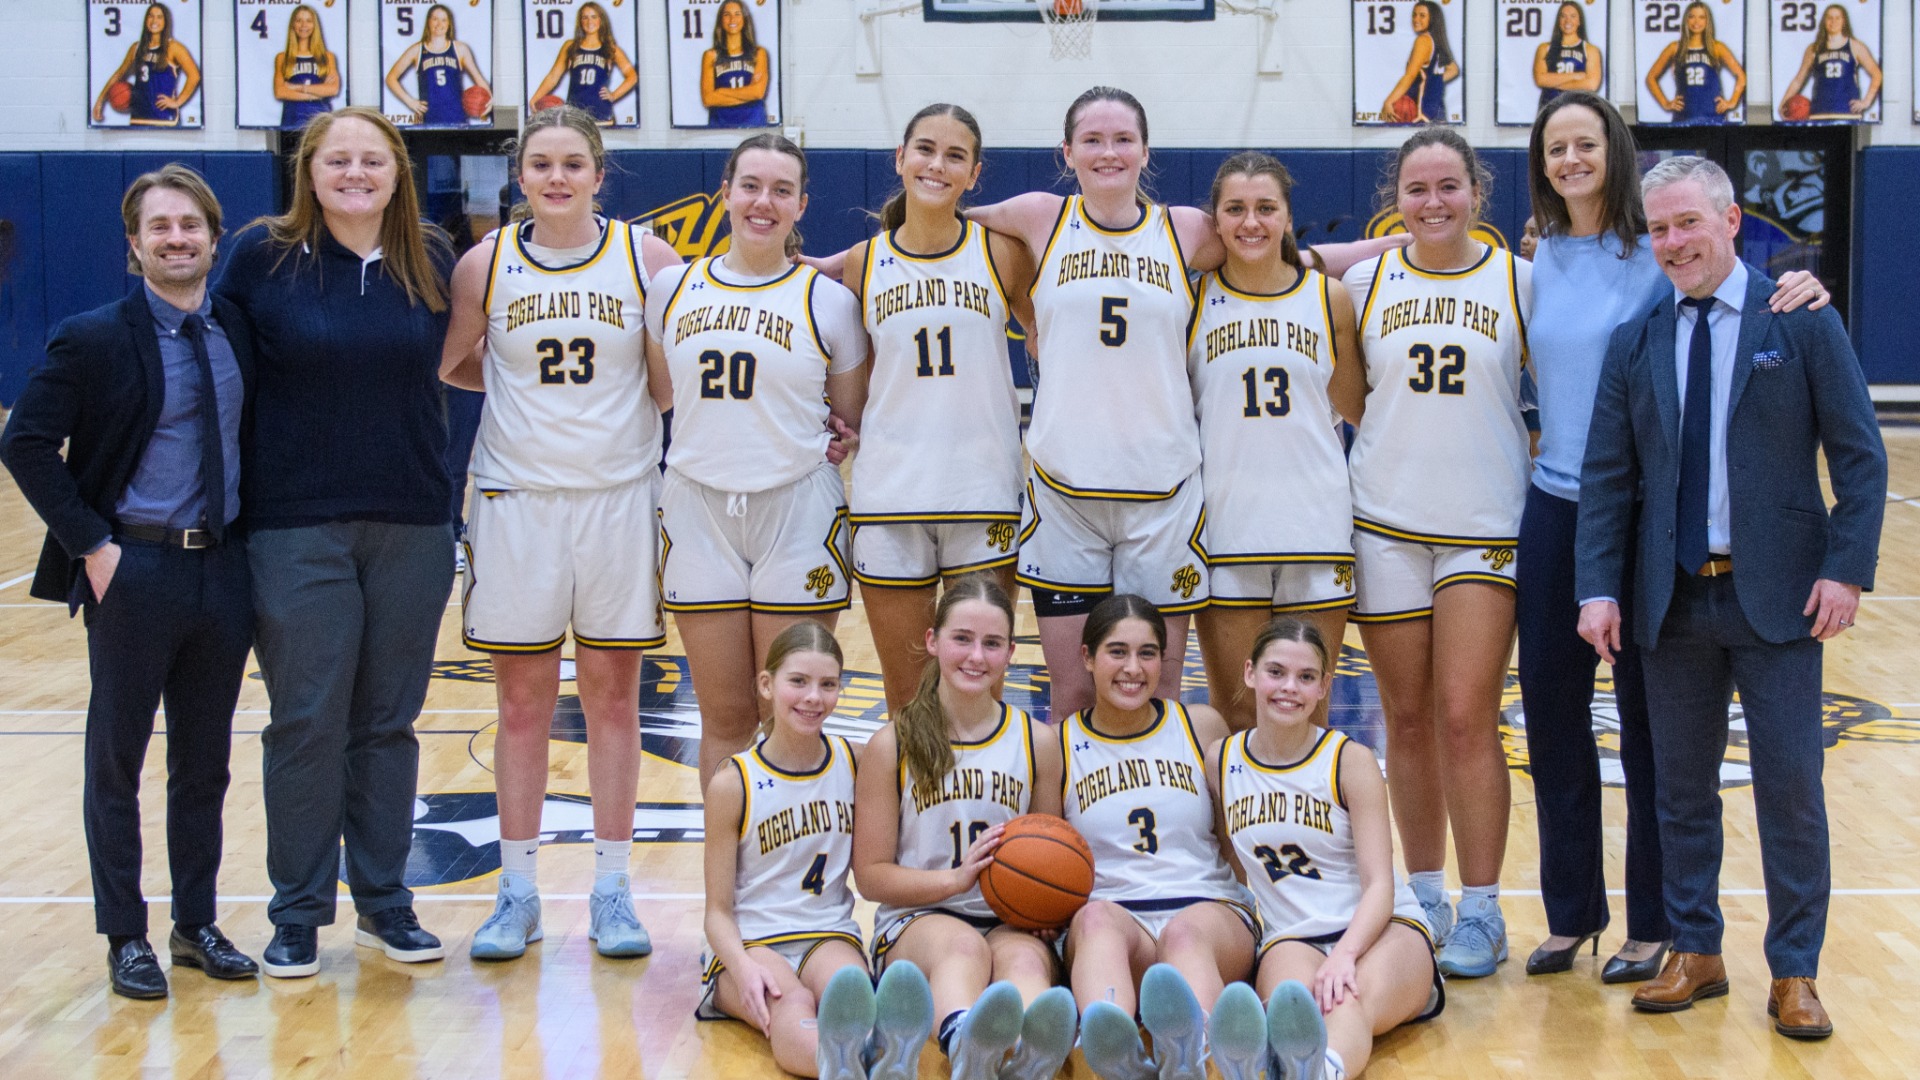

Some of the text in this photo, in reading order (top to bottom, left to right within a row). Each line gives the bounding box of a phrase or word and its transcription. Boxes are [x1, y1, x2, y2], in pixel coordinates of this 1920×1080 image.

[104, 7, 122, 37] 3
[250, 9, 269, 39] 4
[396, 7, 414, 37] 5
[535, 9, 564, 39] 10
[683, 9, 703, 39] 11
[1367, 5, 1396, 35] 13
[1506, 8, 1542, 37] 20
[1645, 3, 1681, 33] 22
[1780, 3, 1817, 32] 23
[141, 65, 149, 82] 3
[436, 69, 447, 87] 5
[580, 68, 596, 86] 10
[1686, 66, 1705, 86] 22
[1825, 61, 1842, 79] 23
[1057, 248, 1173, 294] HIGHLAND PARK
[507, 291, 625, 333] HIGHLAND PARK
[875, 277, 991, 326] HIGHLAND PARK
[1099, 295, 1129, 348] 5
[1381, 297, 1500, 343] HIGHLAND PARK
[675, 304, 794, 353] HIGHLAND PARK
[1206, 318, 1319, 365] HIGHLAND PARK
[535, 336, 596, 385] 23
[913, 325, 956, 378] 11
[1407, 342, 1468, 396] 32
[698, 349, 758, 401] 20
[1241, 366, 1291, 418] 13
[991, 770, 1024, 815] PARK
[1076, 758, 1199, 815] HIGHLAND PARK
[758, 800, 855, 856] HIGHLAND PA
[1127, 806, 1159, 856] 3
[1294, 793, 1334, 835] PARK
[801, 852, 828, 896] 4
[1253, 842, 1323, 884] 22
